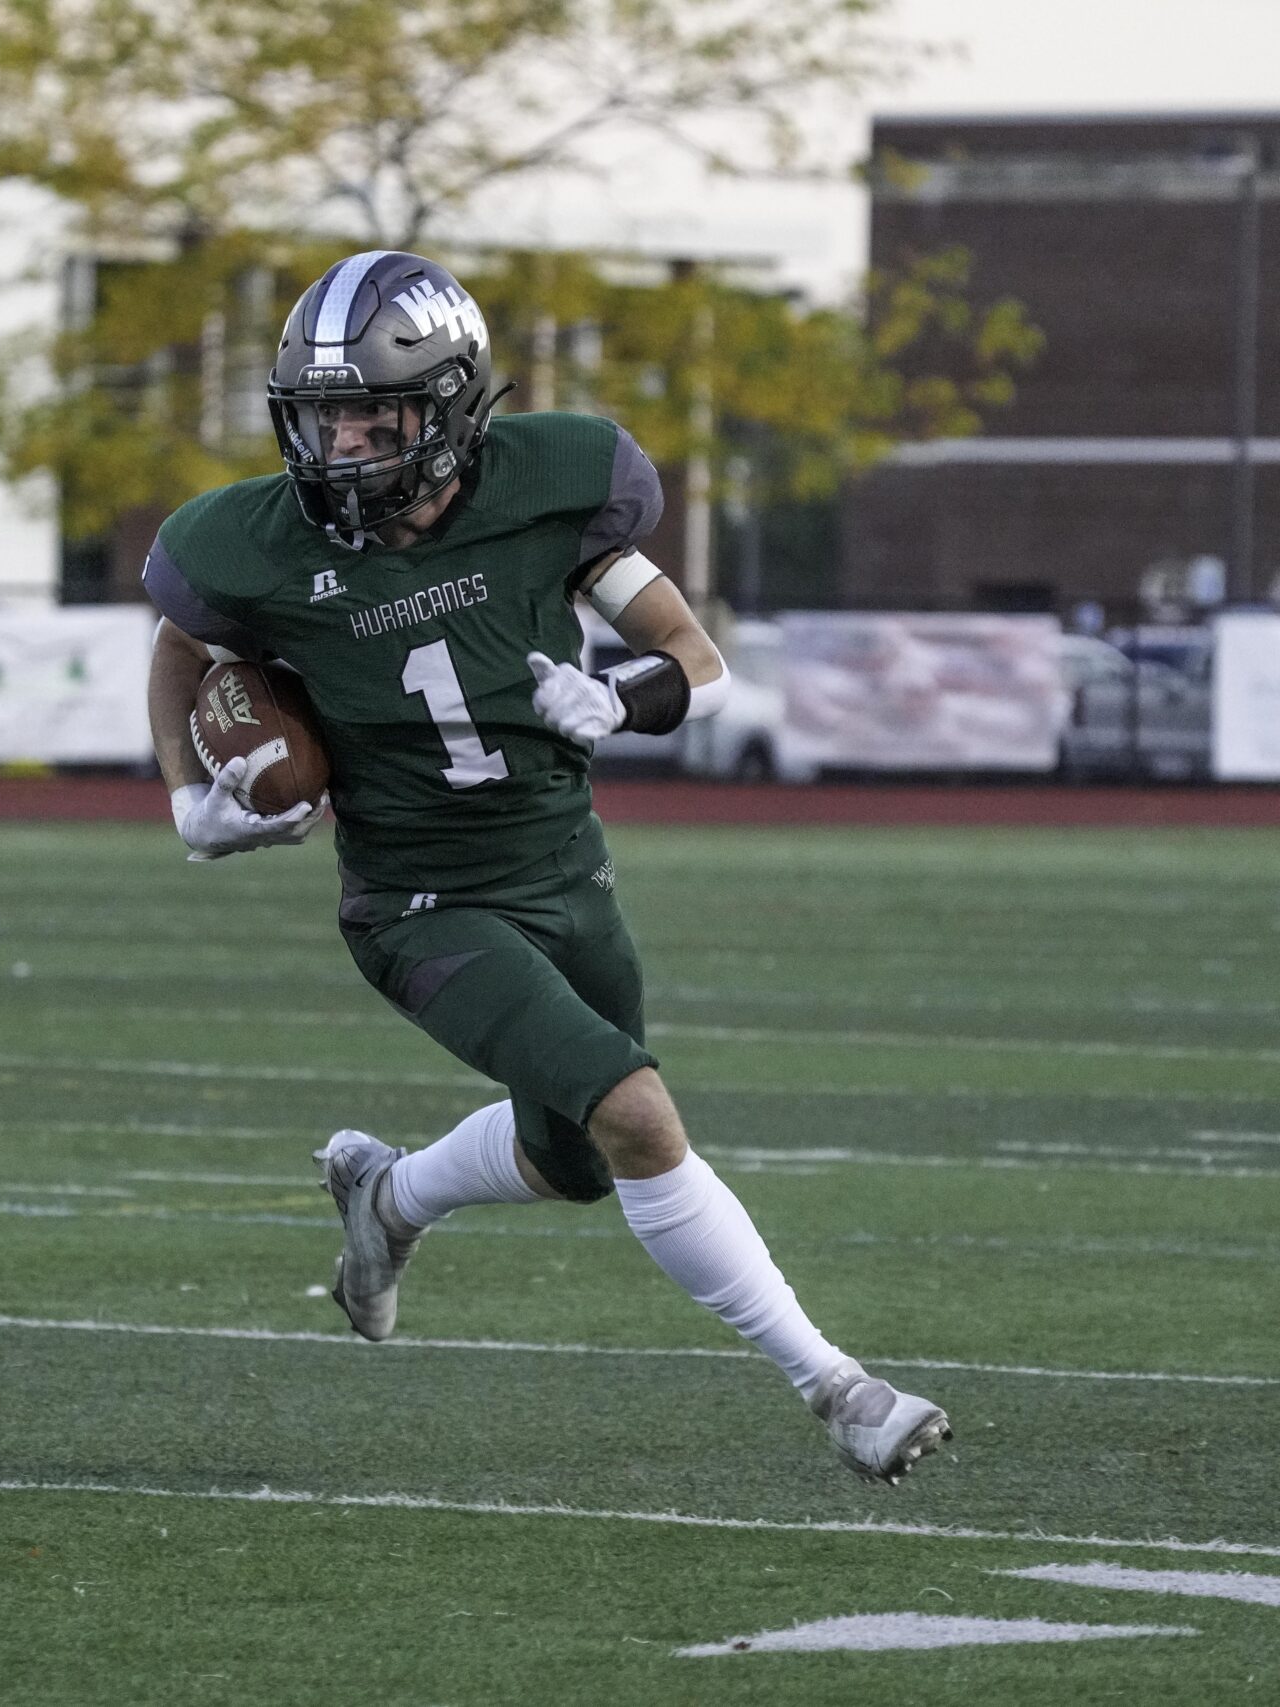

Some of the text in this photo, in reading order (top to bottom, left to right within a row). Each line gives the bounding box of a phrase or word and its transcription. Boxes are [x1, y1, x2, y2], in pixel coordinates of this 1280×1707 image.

[391, 279, 487, 352] WHB
[310, 584, 349, 603] RUSSELL
[350, 573, 488, 639] HURRICANES
[402, 637, 510, 790] 1
